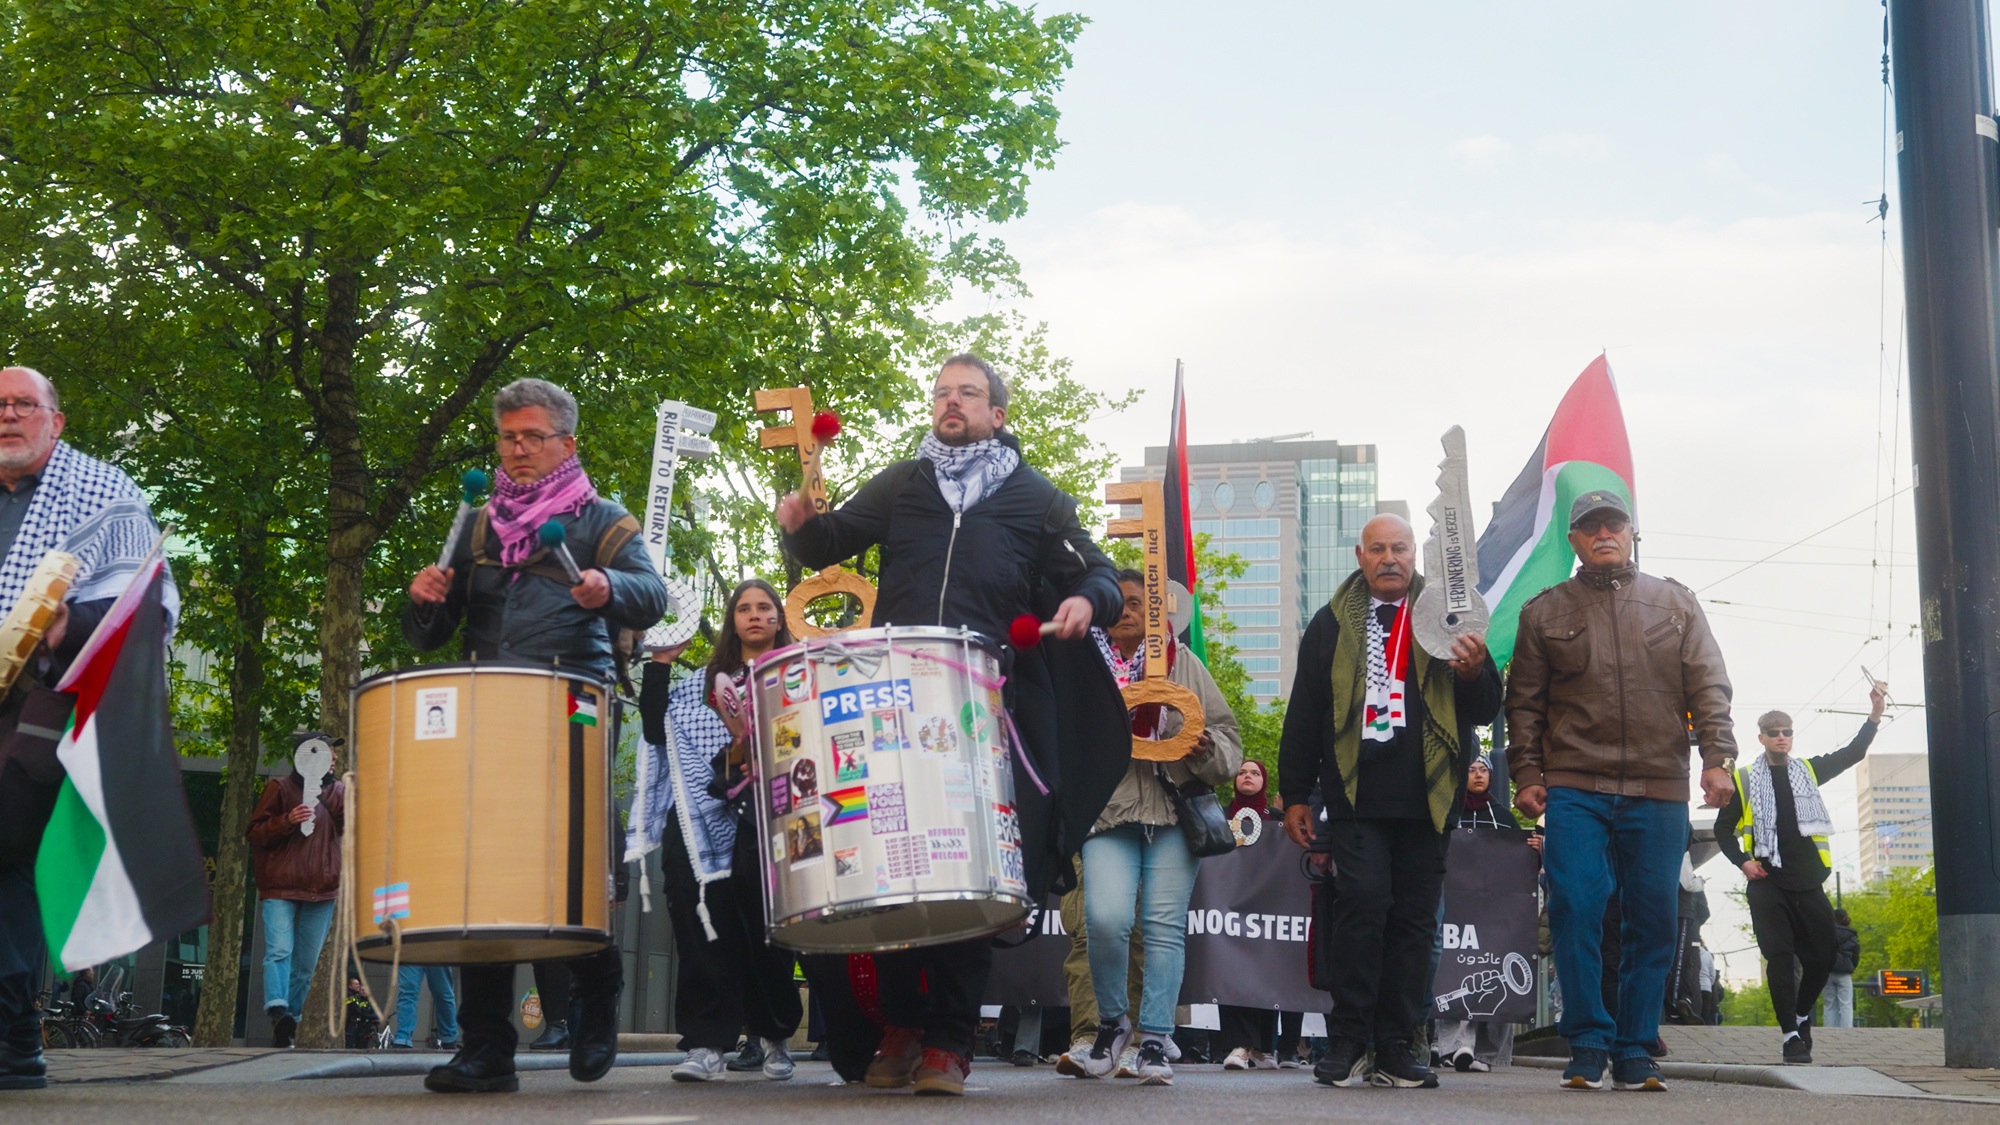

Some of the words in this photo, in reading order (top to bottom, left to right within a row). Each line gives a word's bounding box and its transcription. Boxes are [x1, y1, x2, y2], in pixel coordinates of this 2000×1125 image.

[657, 460, 672, 478] TO
[650, 484, 670, 545] RETURN
[1444, 506, 1458, 538] VERZET
[1147, 528, 1158, 554] niet
[1446, 546, 1467, 610] HERINNERING
[1148, 564, 1162, 627] vergeten
[821, 685, 912, 718] PRESS
[868, 783, 903, 798] FUCK
[869, 794, 904, 810] YOUR
[872, 816, 906, 834] SHIT
[928, 828, 965, 837] REFUGEES
[931, 851, 968, 860] WELCOME
[1188, 909, 1240, 937] NOG
[1443, 923, 1479, 950] BA
[1457, 952, 1500, 965] عائدون
